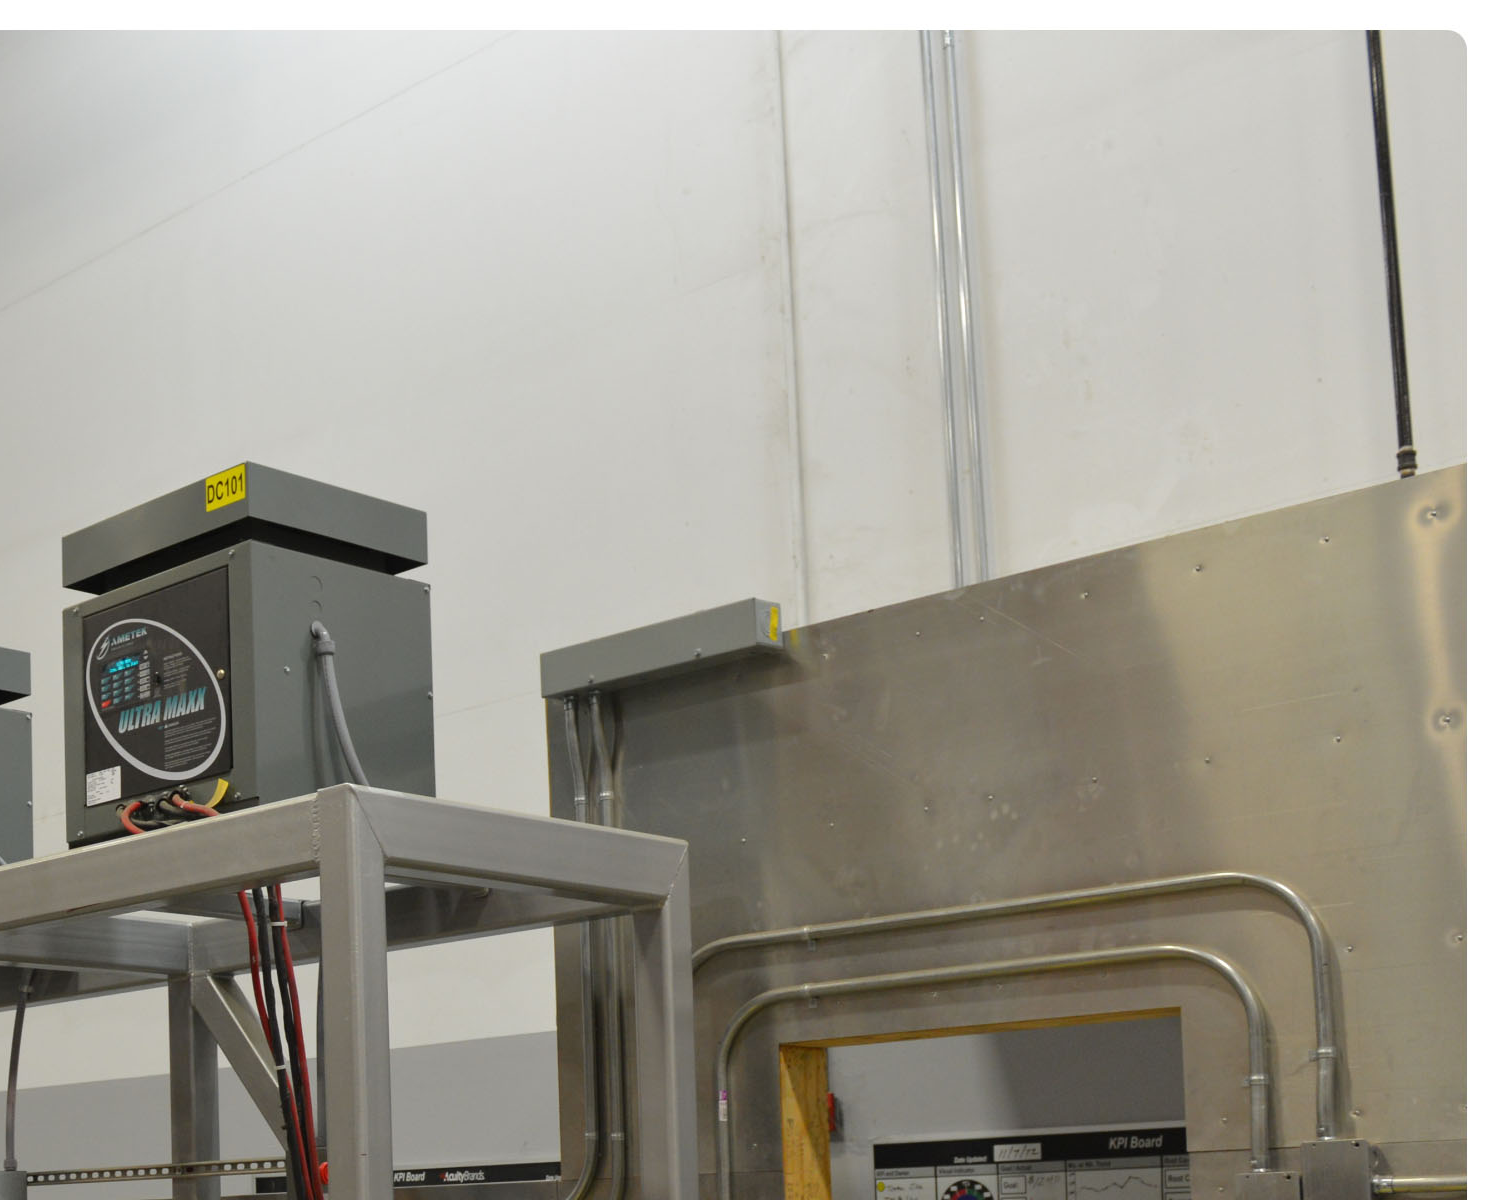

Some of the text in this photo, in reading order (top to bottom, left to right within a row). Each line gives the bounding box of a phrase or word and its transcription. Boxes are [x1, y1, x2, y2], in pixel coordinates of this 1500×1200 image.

[207, 472, 243, 504] DC101
[110, 627, 148, 646] AMETEK
[118, 686, 208, 733] ULTRA MAXX
[1109, 1135, 1163, 1150] KPI Board
[393, 1171, 425, 1182] KPI Board
